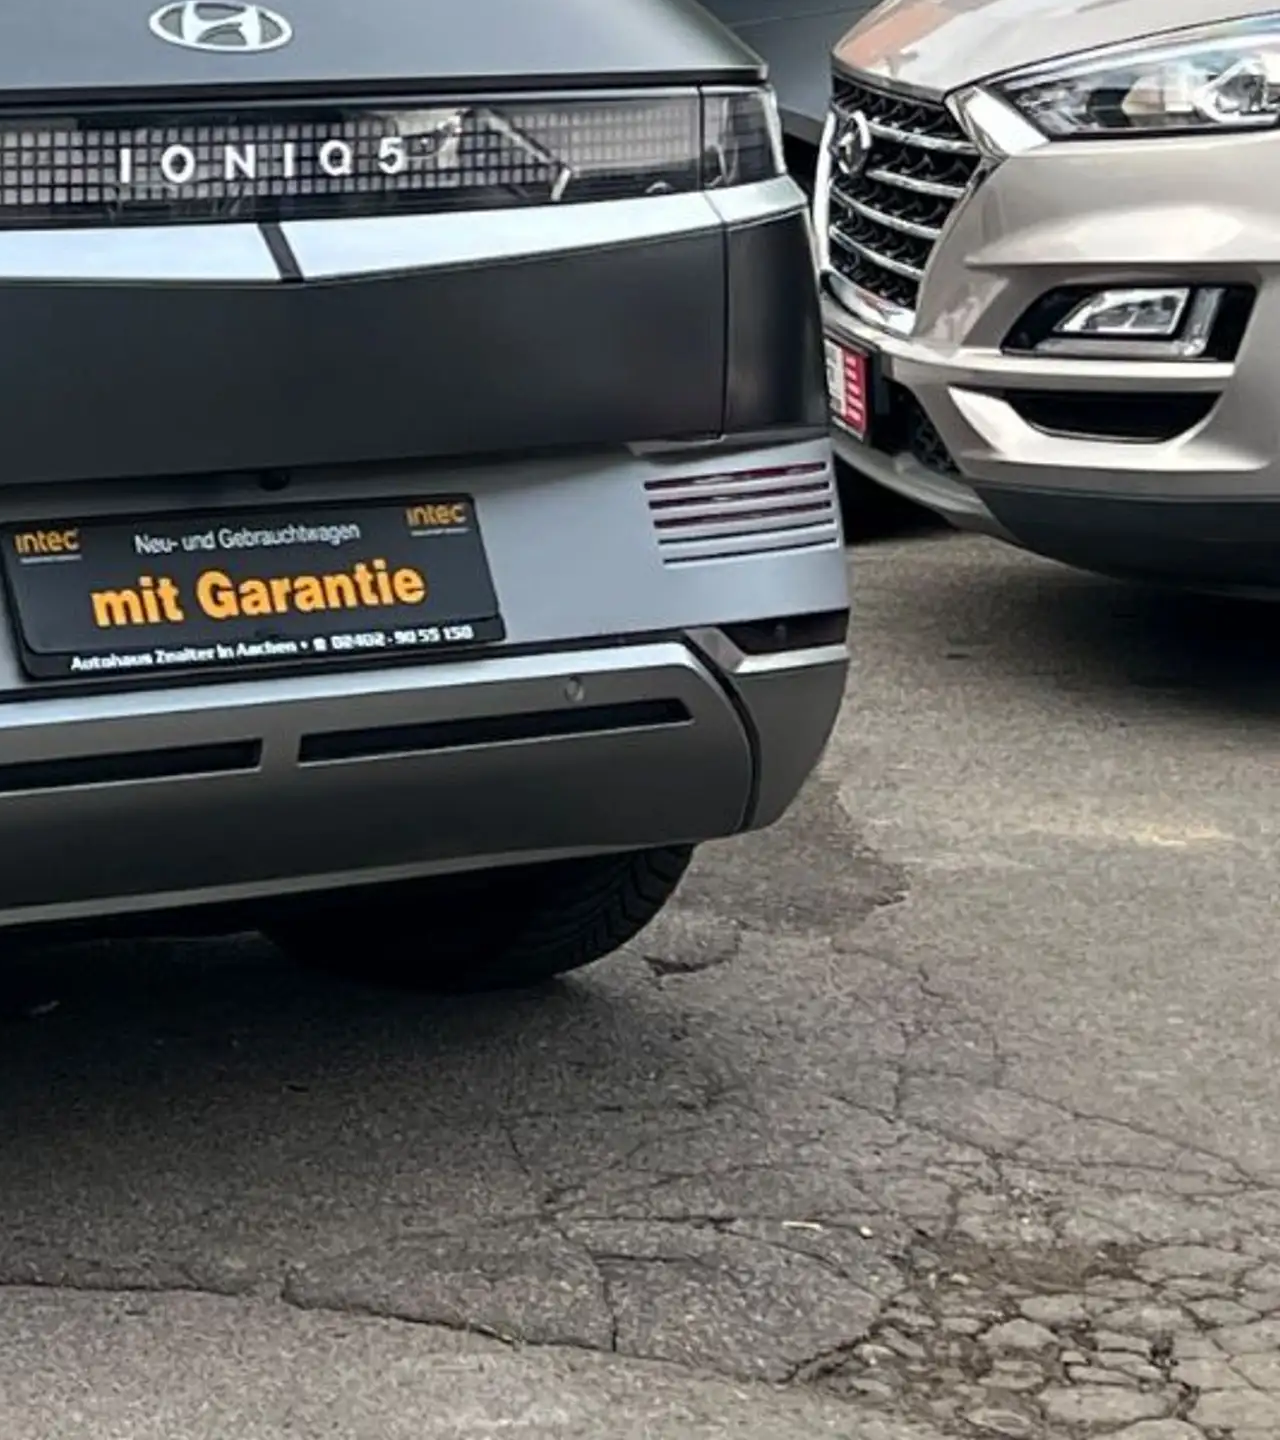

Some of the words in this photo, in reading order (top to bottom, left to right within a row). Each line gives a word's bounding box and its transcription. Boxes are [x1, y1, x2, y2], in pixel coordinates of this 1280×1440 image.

[134, 532, 179, 554] Neu-
[181, 530, 216, 551] und
[218, 522, 362, 549] Gebrauchtwagen
[90, 574, 184, 628] mit
[196, 557, 427, 620] Garantie
[70, 654, 153, 672] Autohaus
[216, 643, 235, 659] in
